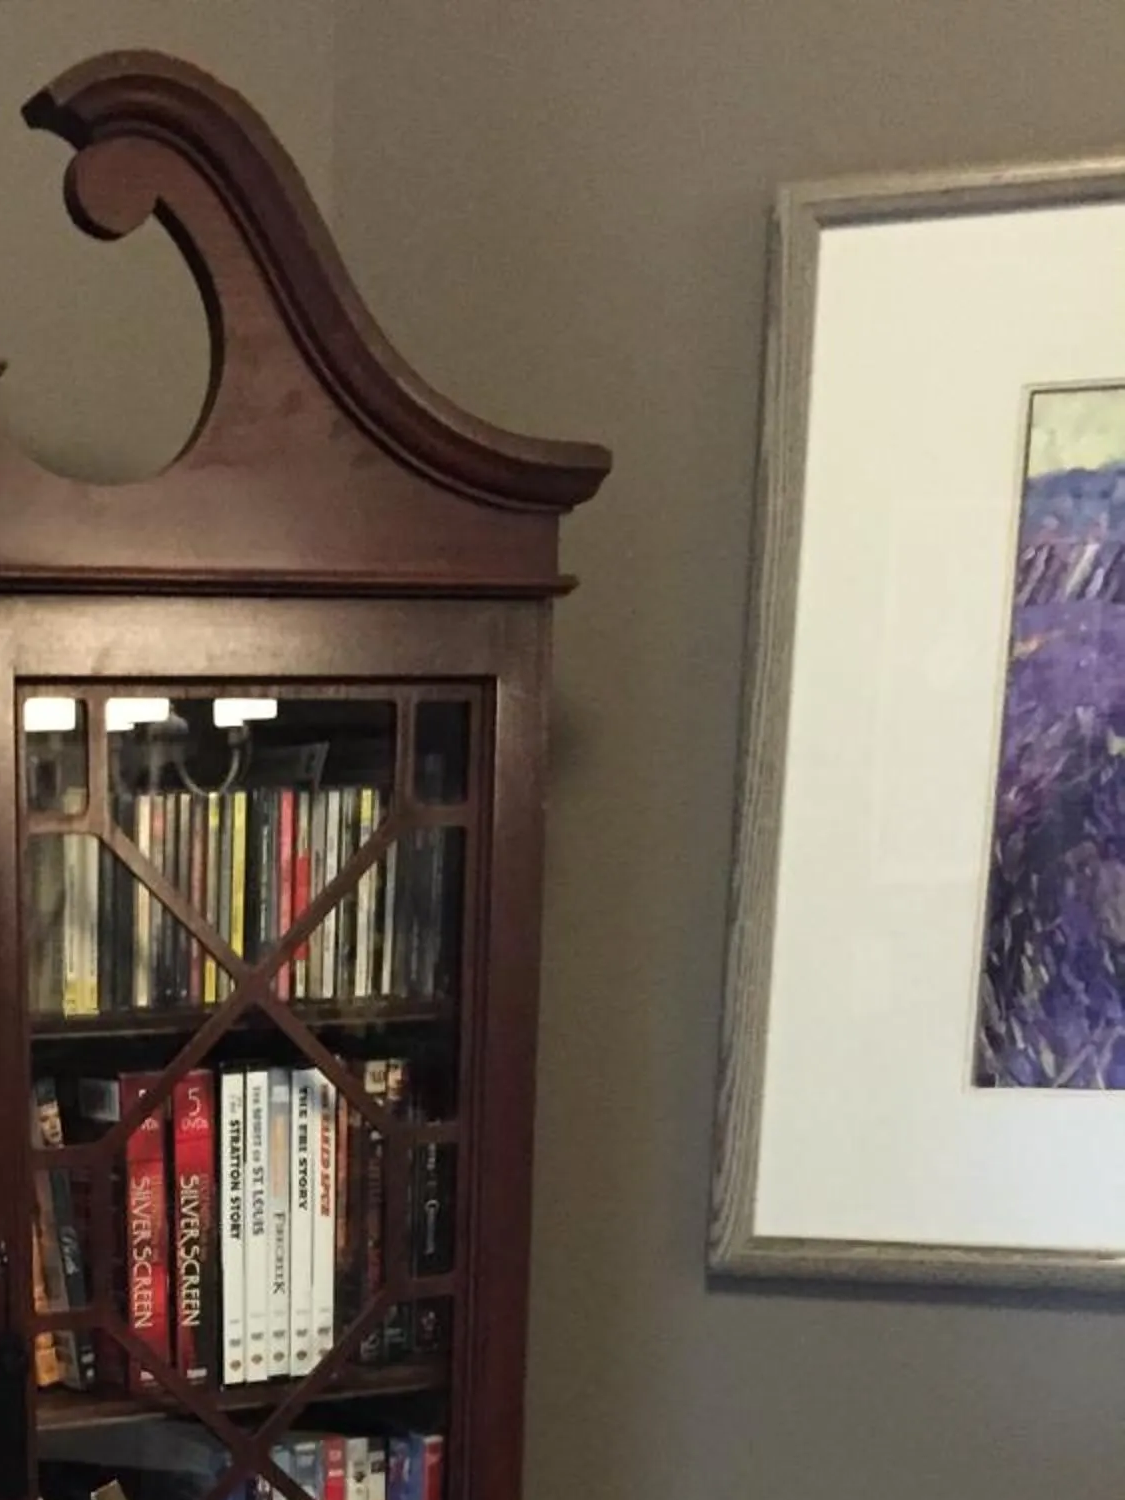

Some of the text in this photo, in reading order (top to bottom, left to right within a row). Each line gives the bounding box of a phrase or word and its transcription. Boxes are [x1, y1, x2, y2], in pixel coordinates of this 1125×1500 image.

[298, 1086, 308, 1118] THE
[229, 1119, 241, 1191] STRATTON
[298, 1157, 308, 1211] STORY
[229, 1196, 241, 1240] STORY
[252, 1189, 264, 1236] LOUIS
[130, 1175, 154, 1329] SILVER SCREEN
[179, 1173, 201, 1327] SILVER SCREEN
